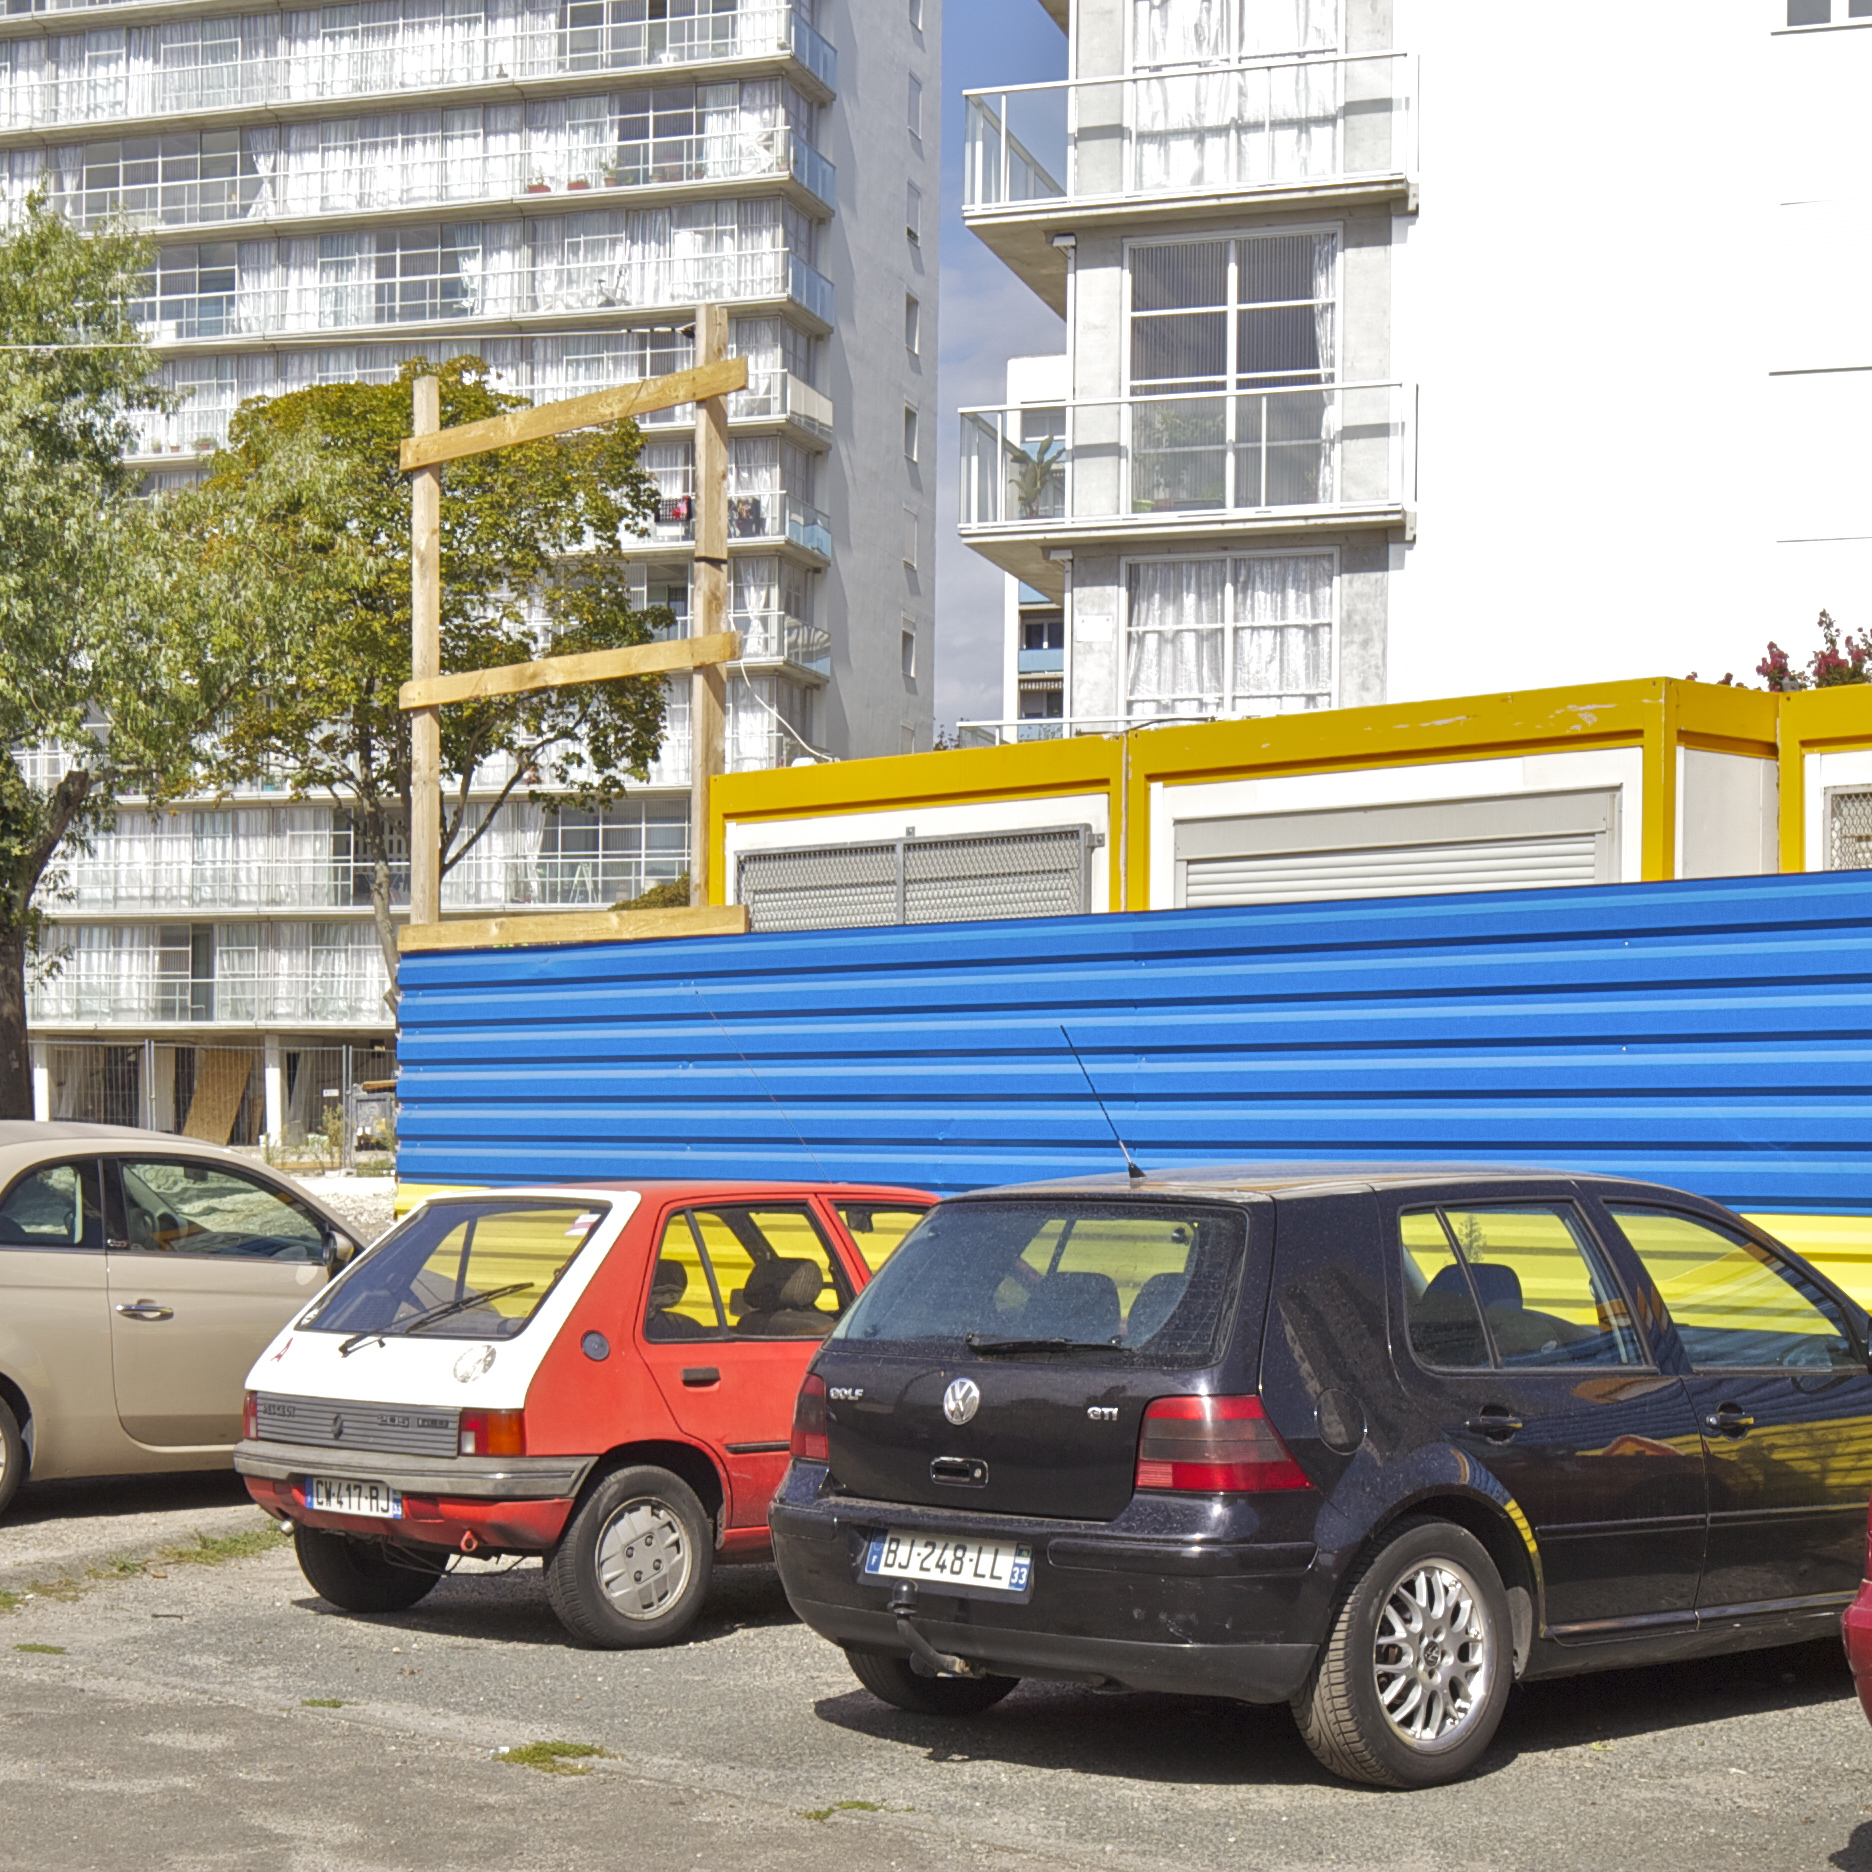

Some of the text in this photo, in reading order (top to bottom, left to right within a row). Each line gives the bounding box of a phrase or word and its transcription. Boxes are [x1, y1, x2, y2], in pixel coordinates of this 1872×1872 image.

[829, 1387, 864, 1401] GOLF
[1087, 1406, 1119, 1421] GTI
[377, 1415, 409, 1428] 205
[883, 1536, 1003, 1581] BJ-248-LL
[1010, 1566, 1028, 1585] 33
